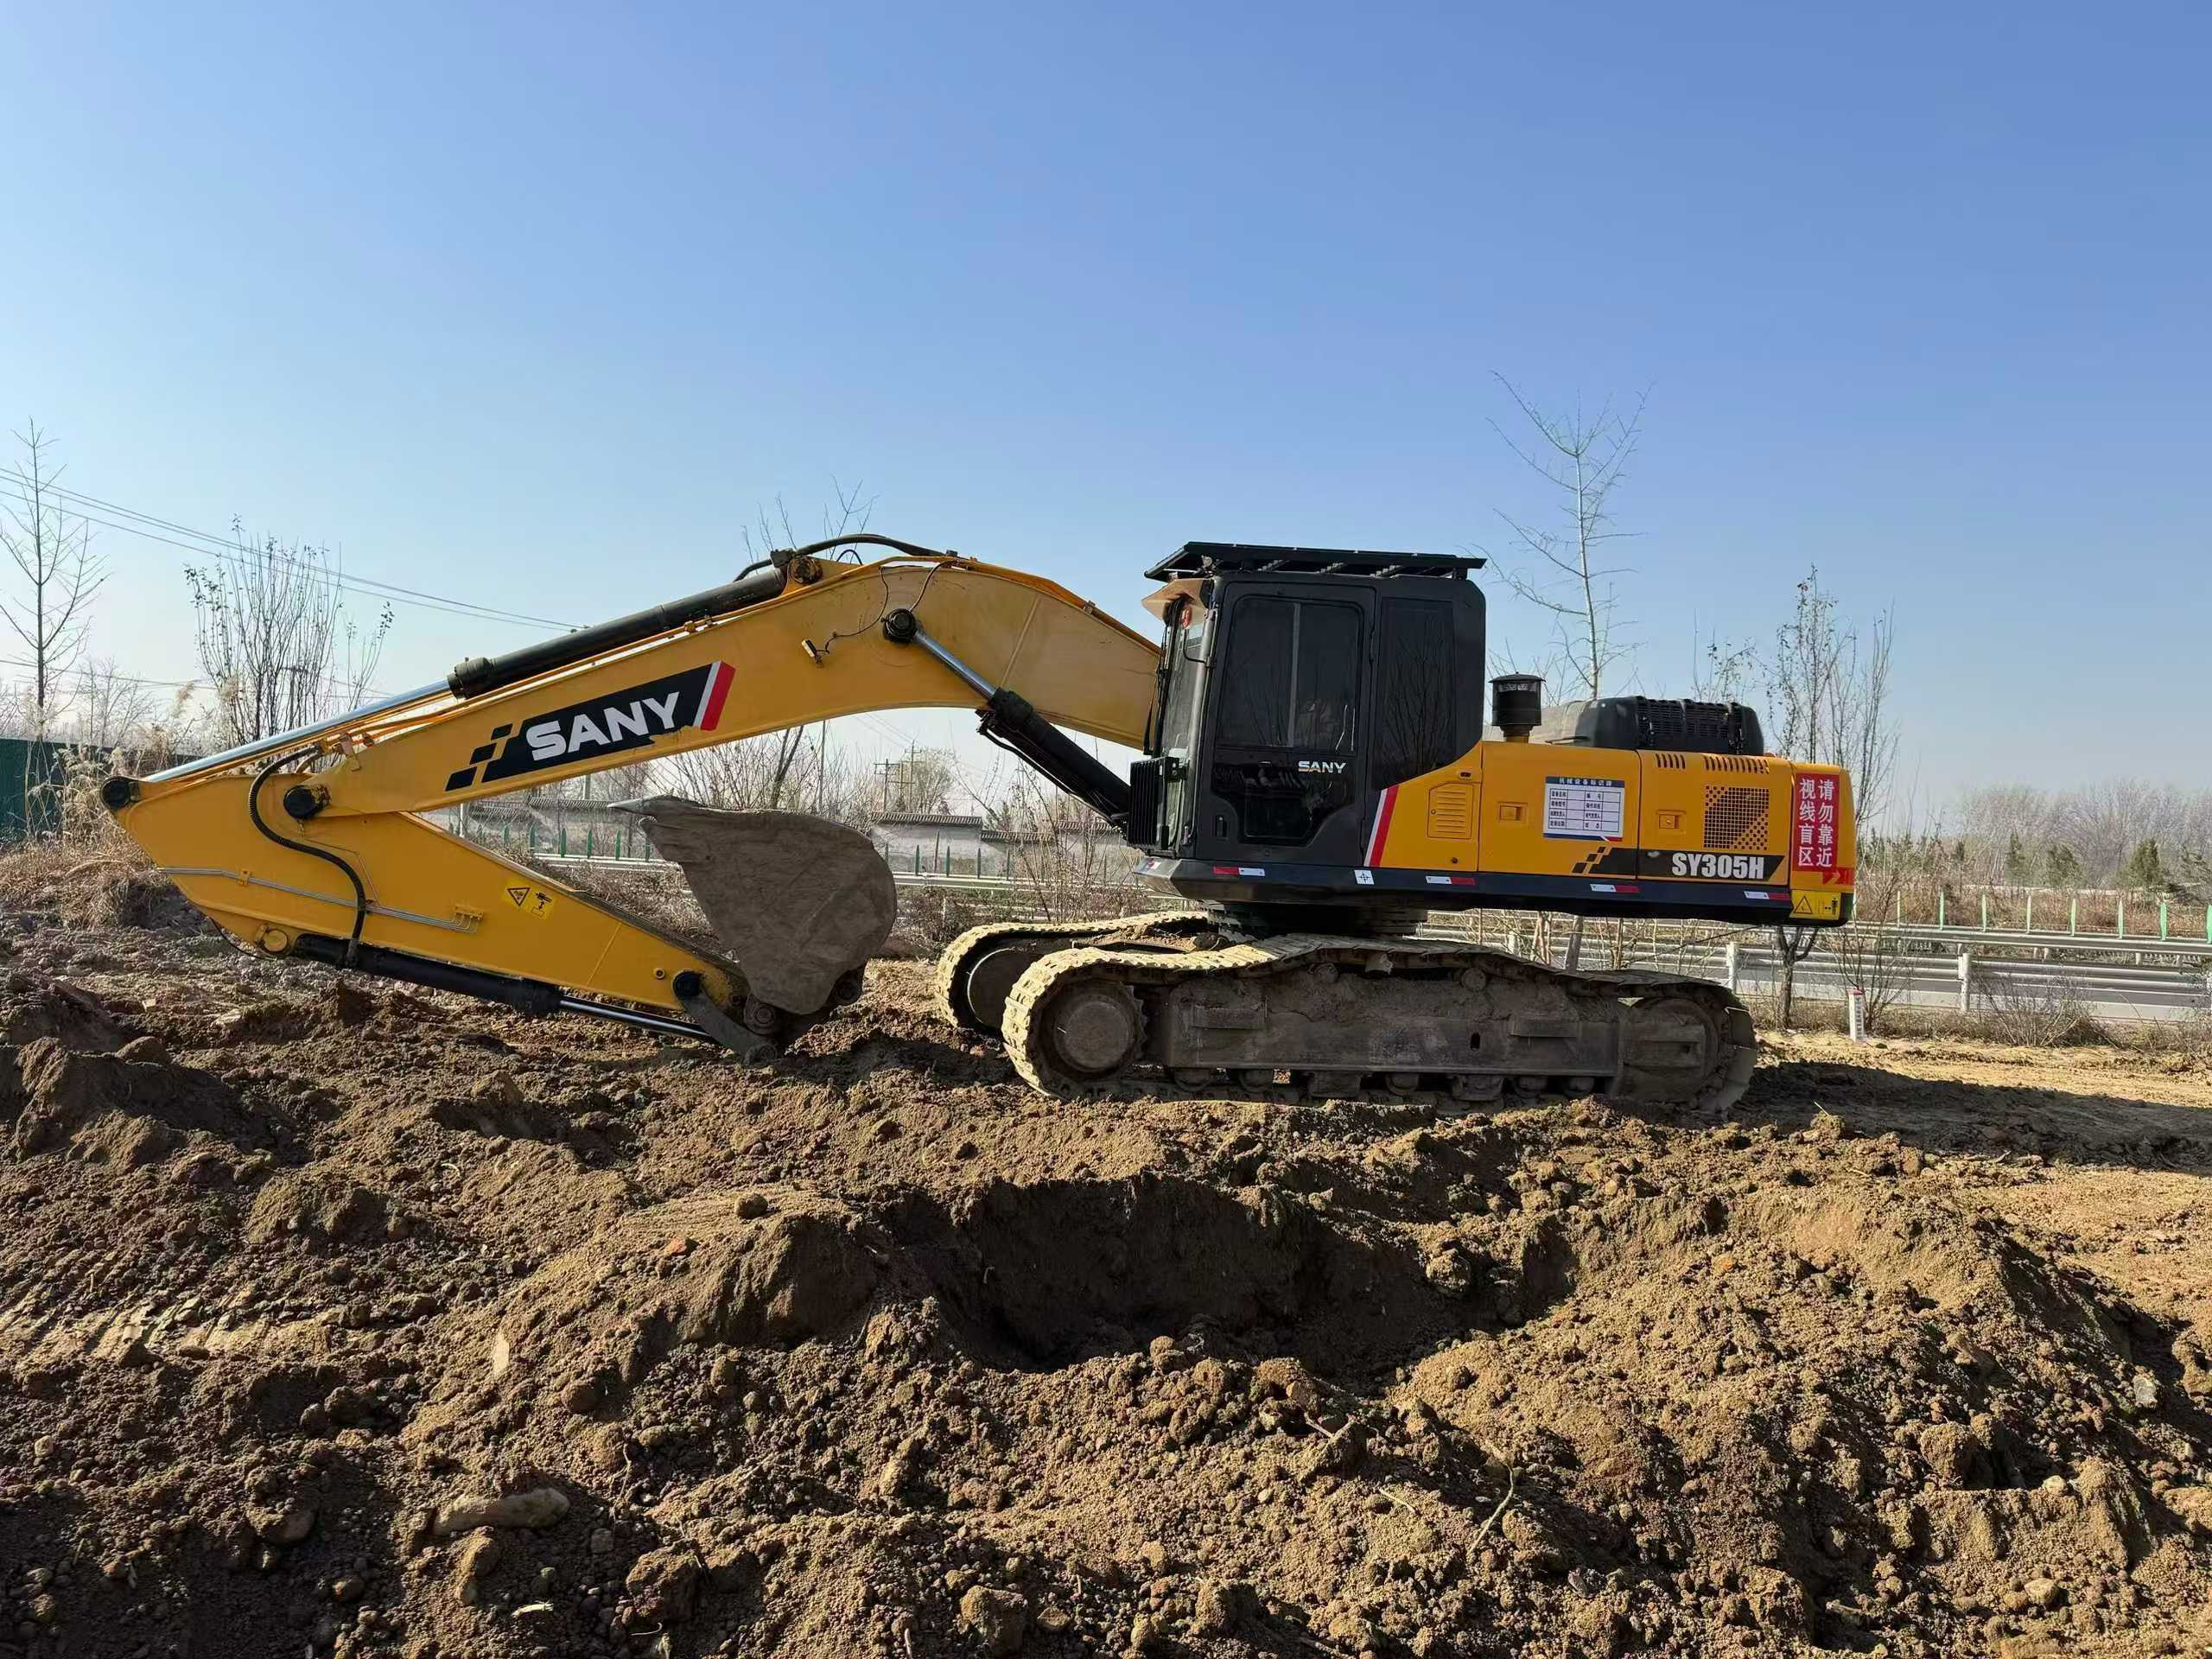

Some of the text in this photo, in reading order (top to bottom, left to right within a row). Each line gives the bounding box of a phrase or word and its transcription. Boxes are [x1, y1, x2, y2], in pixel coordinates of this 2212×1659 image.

[526, 692, 680, 761] SANY
[1298, 760, 1346, 773] SANY
[1798, 778, 1815, 867] 视线盲区
[1816, 779, 1834, 868] 请勿靠近
[1672, 852, 1764, 880] SY305H
